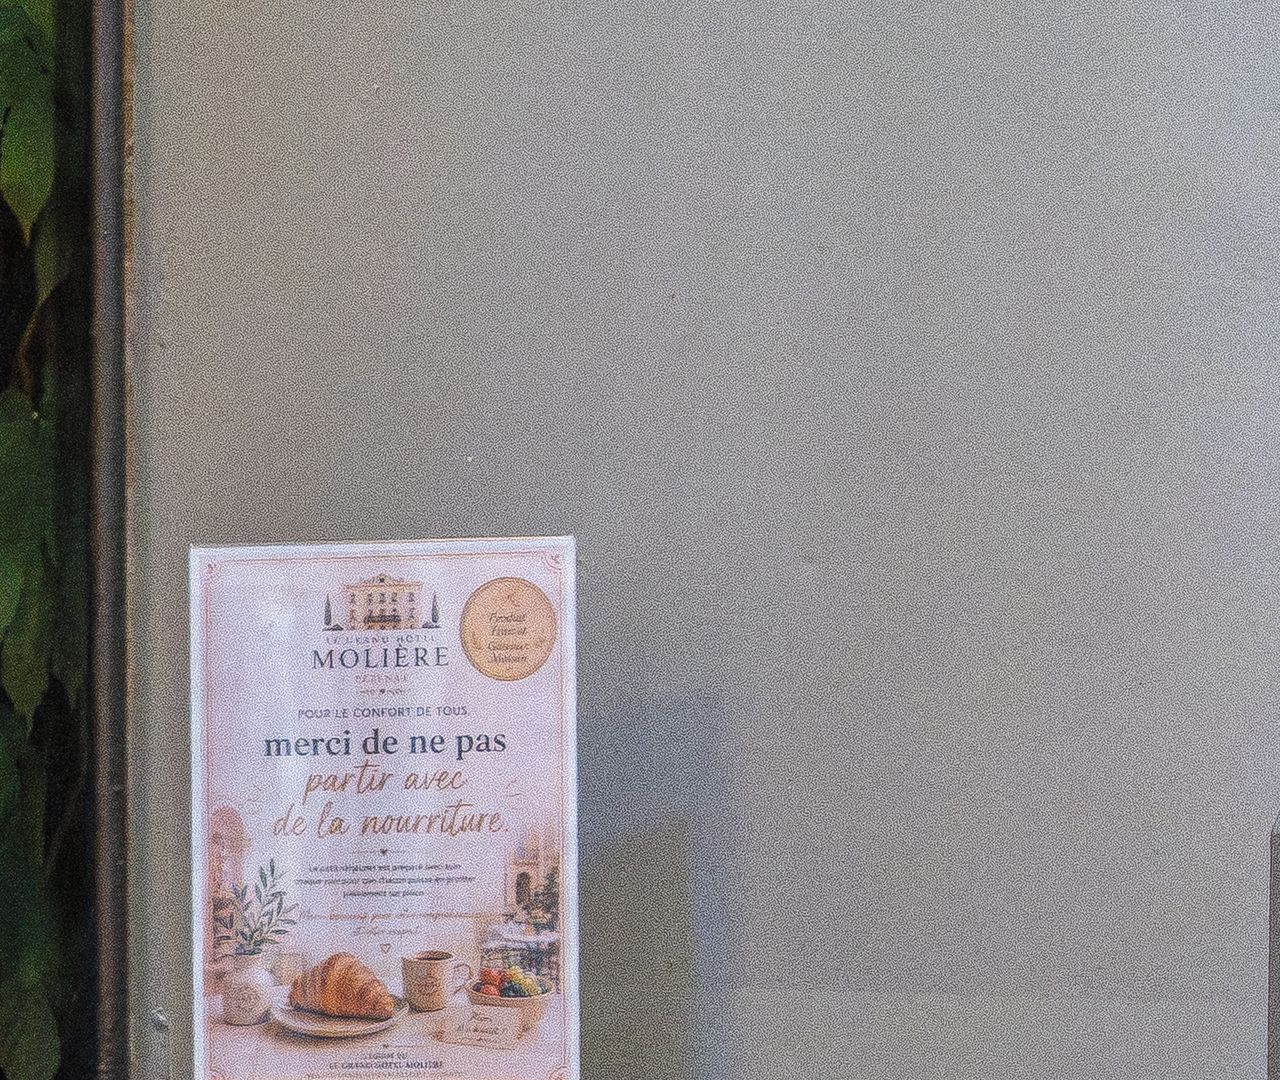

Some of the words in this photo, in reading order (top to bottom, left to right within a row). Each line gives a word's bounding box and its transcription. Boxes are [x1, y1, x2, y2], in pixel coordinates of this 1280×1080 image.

[312, 644, 449, 669] MOLIÈRE
[298, 709, 331, 719] POUR
[335, 708, 347, 718] LE
[353, 706, 411, 718] CONFORT
[416, 706, 432, 717] DE
[263, 730, 352, 756] merci
[362, 728, 398, 755] de
[410, 732, 445, 754] ne
[456, 732, 507, 760] pas
[301, 759, 393, 805] partir
[404, 769, 467, 791] avec
[272, 803, 307, 836] de
[317, 801, 349, 838] la
